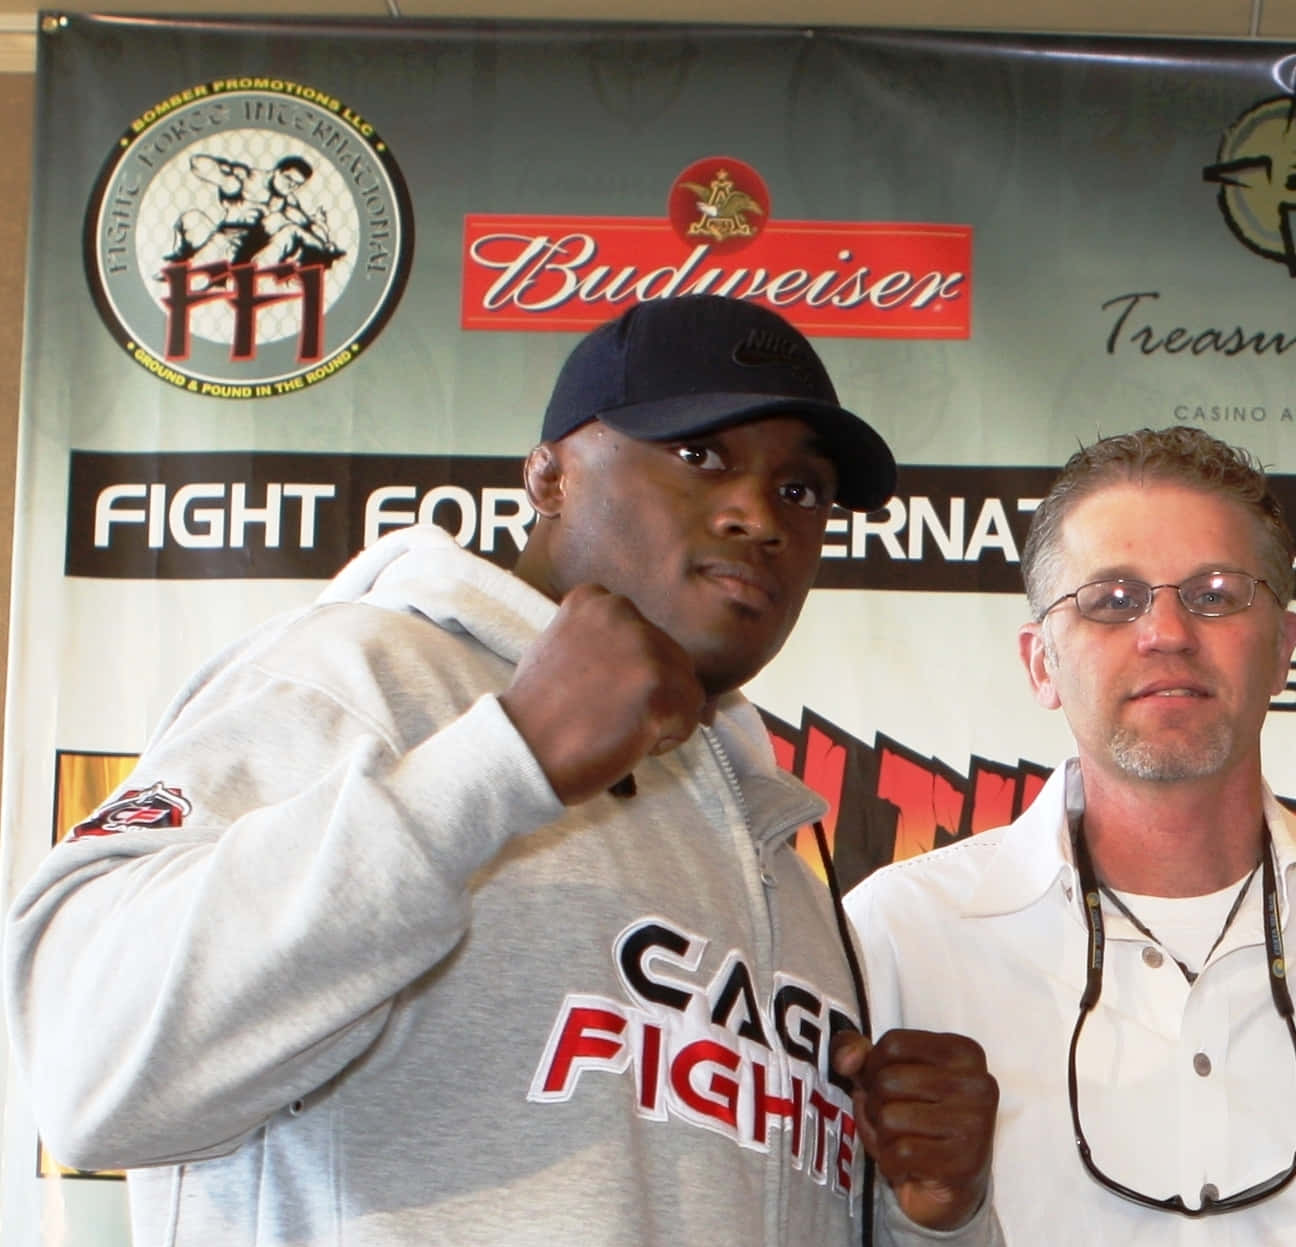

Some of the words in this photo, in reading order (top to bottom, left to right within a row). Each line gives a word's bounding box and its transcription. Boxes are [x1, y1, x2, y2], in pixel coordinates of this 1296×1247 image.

[131, 85, 209, 132] BOMBER
[213, 78, 340, 112] PROMOTIONS
[343, 108, 374, 137] LLC
[469, 233, 965, 312] Budweiser
[134, 349, 186, 386] GROUND
[188, 381, 198, 391] &
[202, 382, 252, 398] POUND
[256, 385, 272, 397] IN
[276, 378, 303, 394] THE
[307, 352, 352, 384] ROUND
[1174, 404, 1267, 423] CASINO
[94, 484, 335, 548] FIGHT
[364, 484, 541, 552] FOR
[542, 1005, 858, 1192] FIGHTE
